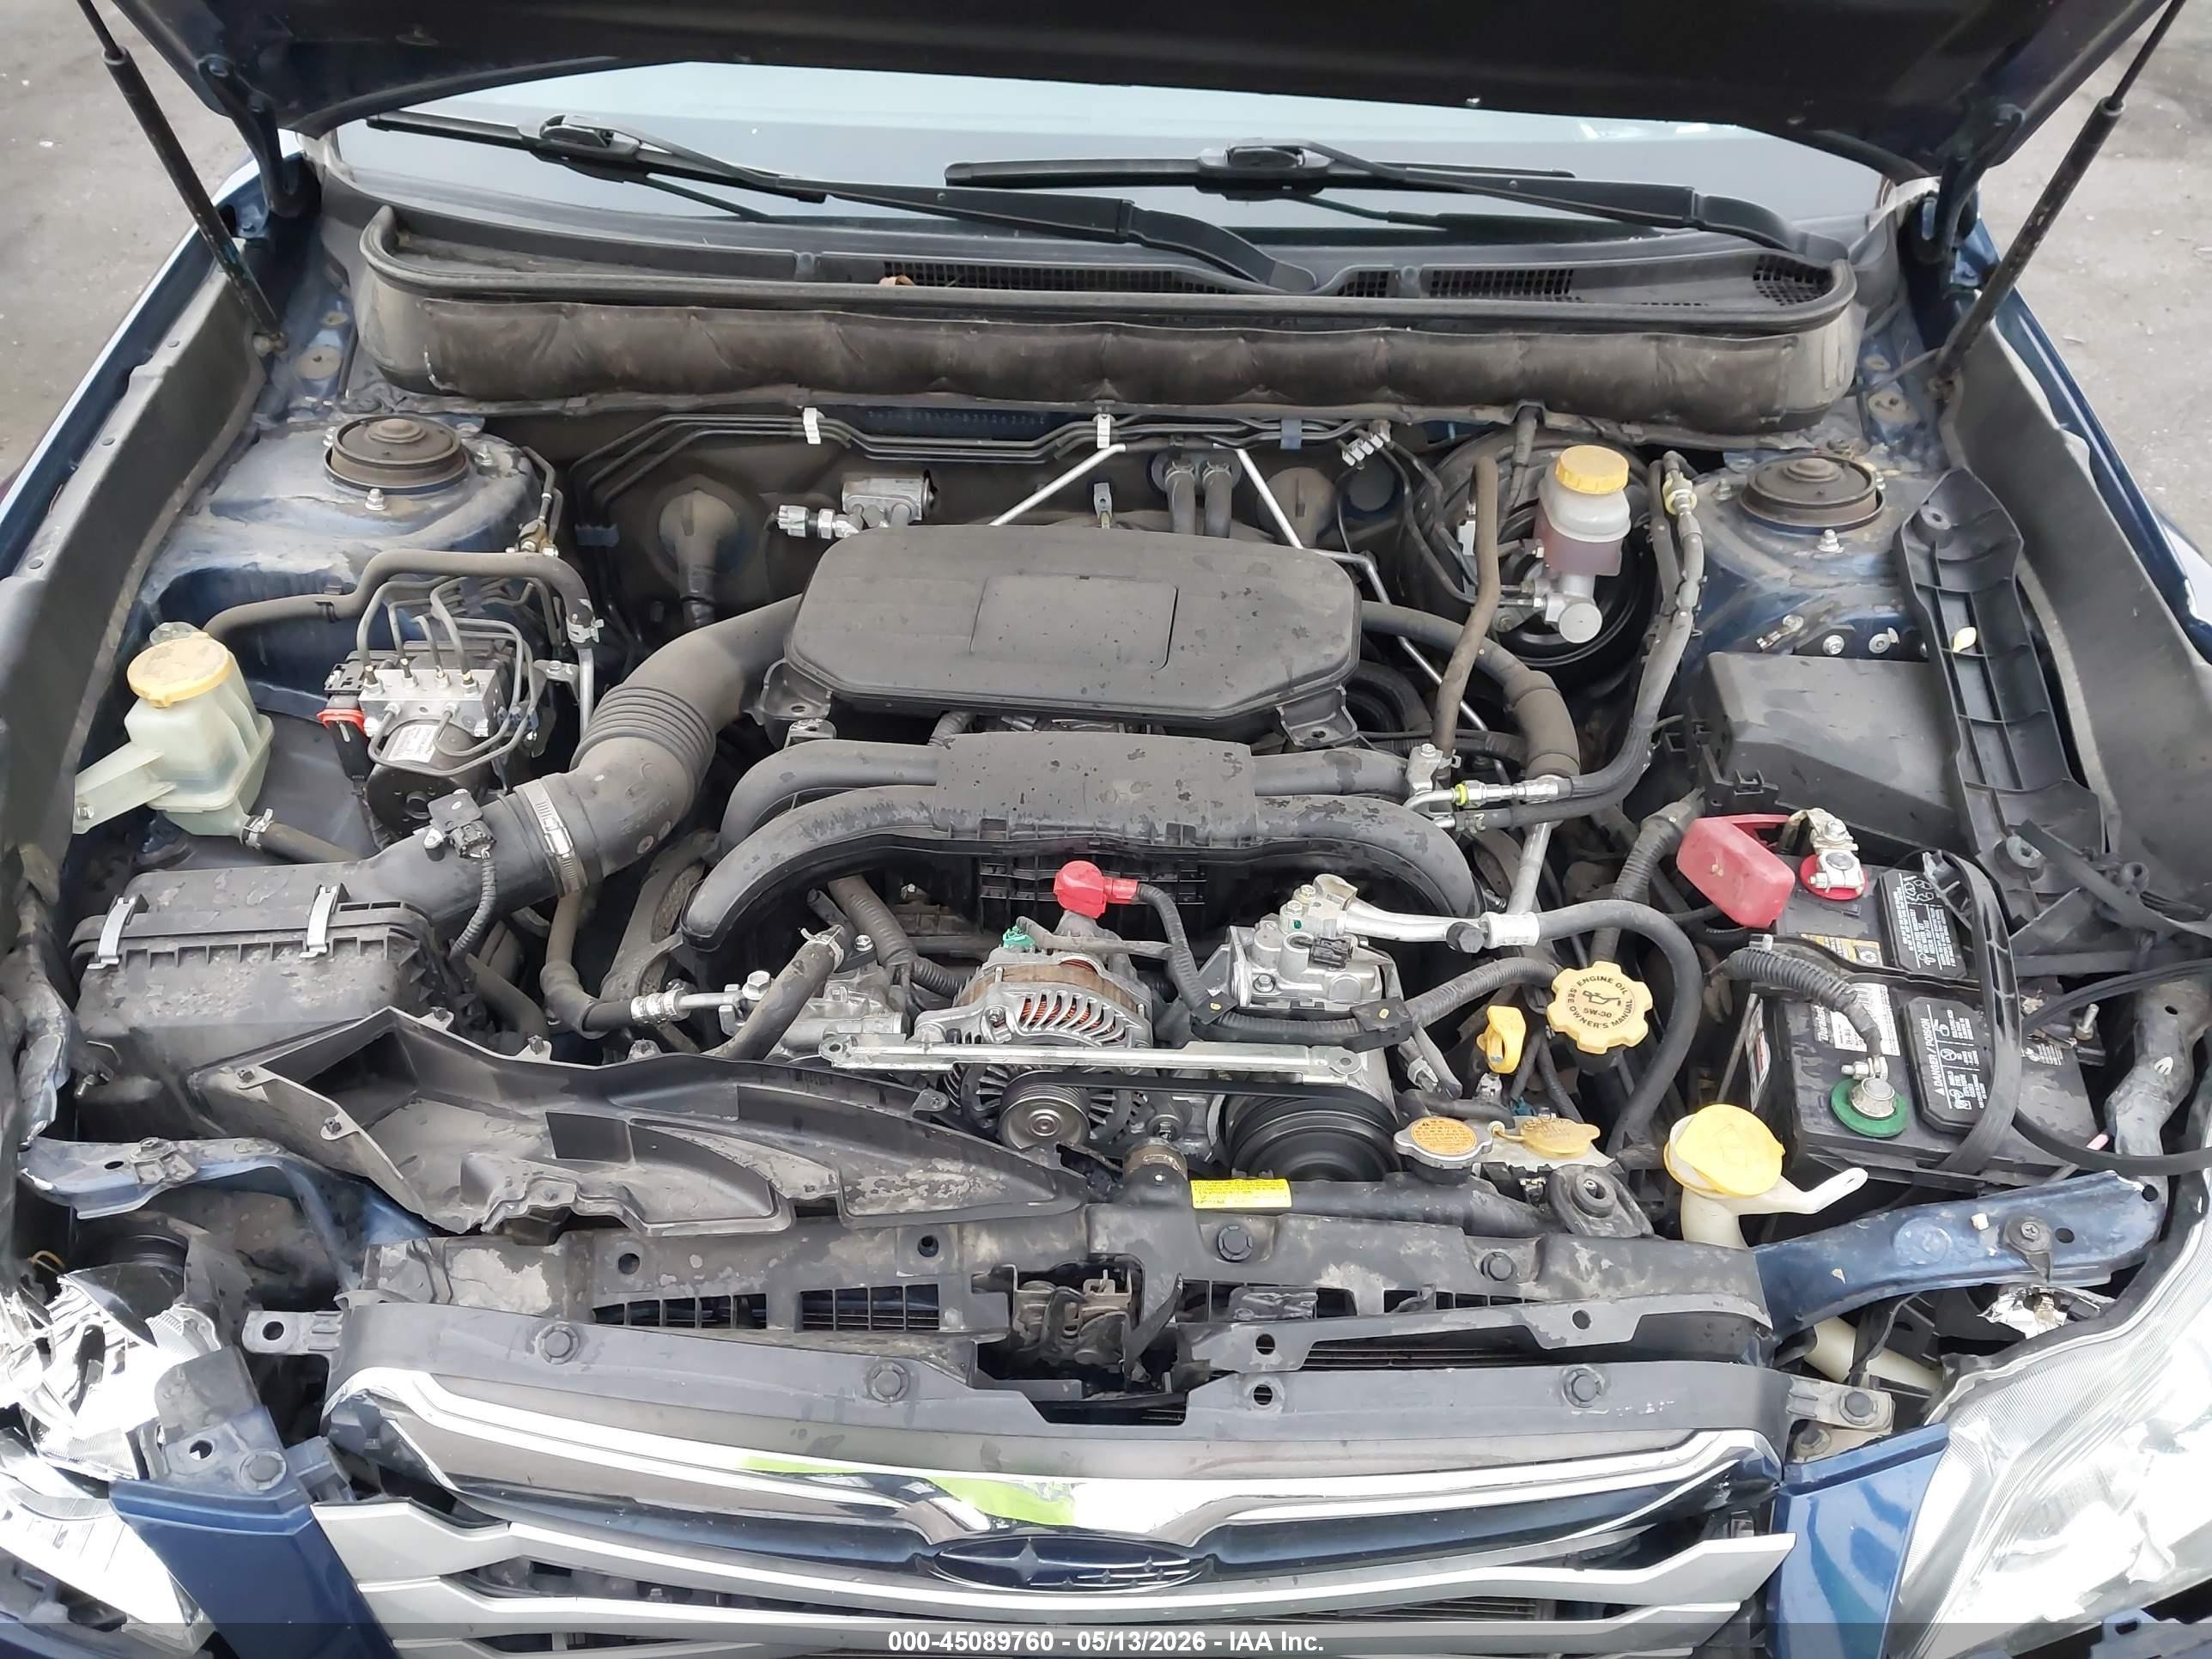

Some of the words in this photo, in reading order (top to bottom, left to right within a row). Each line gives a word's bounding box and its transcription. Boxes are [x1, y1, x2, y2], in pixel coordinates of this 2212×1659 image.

[1567, 988, 1577, 1003] SEE
[1577, 975, 1613, 987] ENGINE
[1615, 982, 1628, 995] OIL
[1569, 1006, 1609, 1029] OWNER'S
[1583, 1007, 1612, 1018] 5W-30
[1611, 999, 1632, 1027] MANUAL
[1814, 1005, 1828, 1042] Duralast
[1920, 1018, 1935, 1047] POISON
[1929, 1054, 1943, 1088] DANGER
